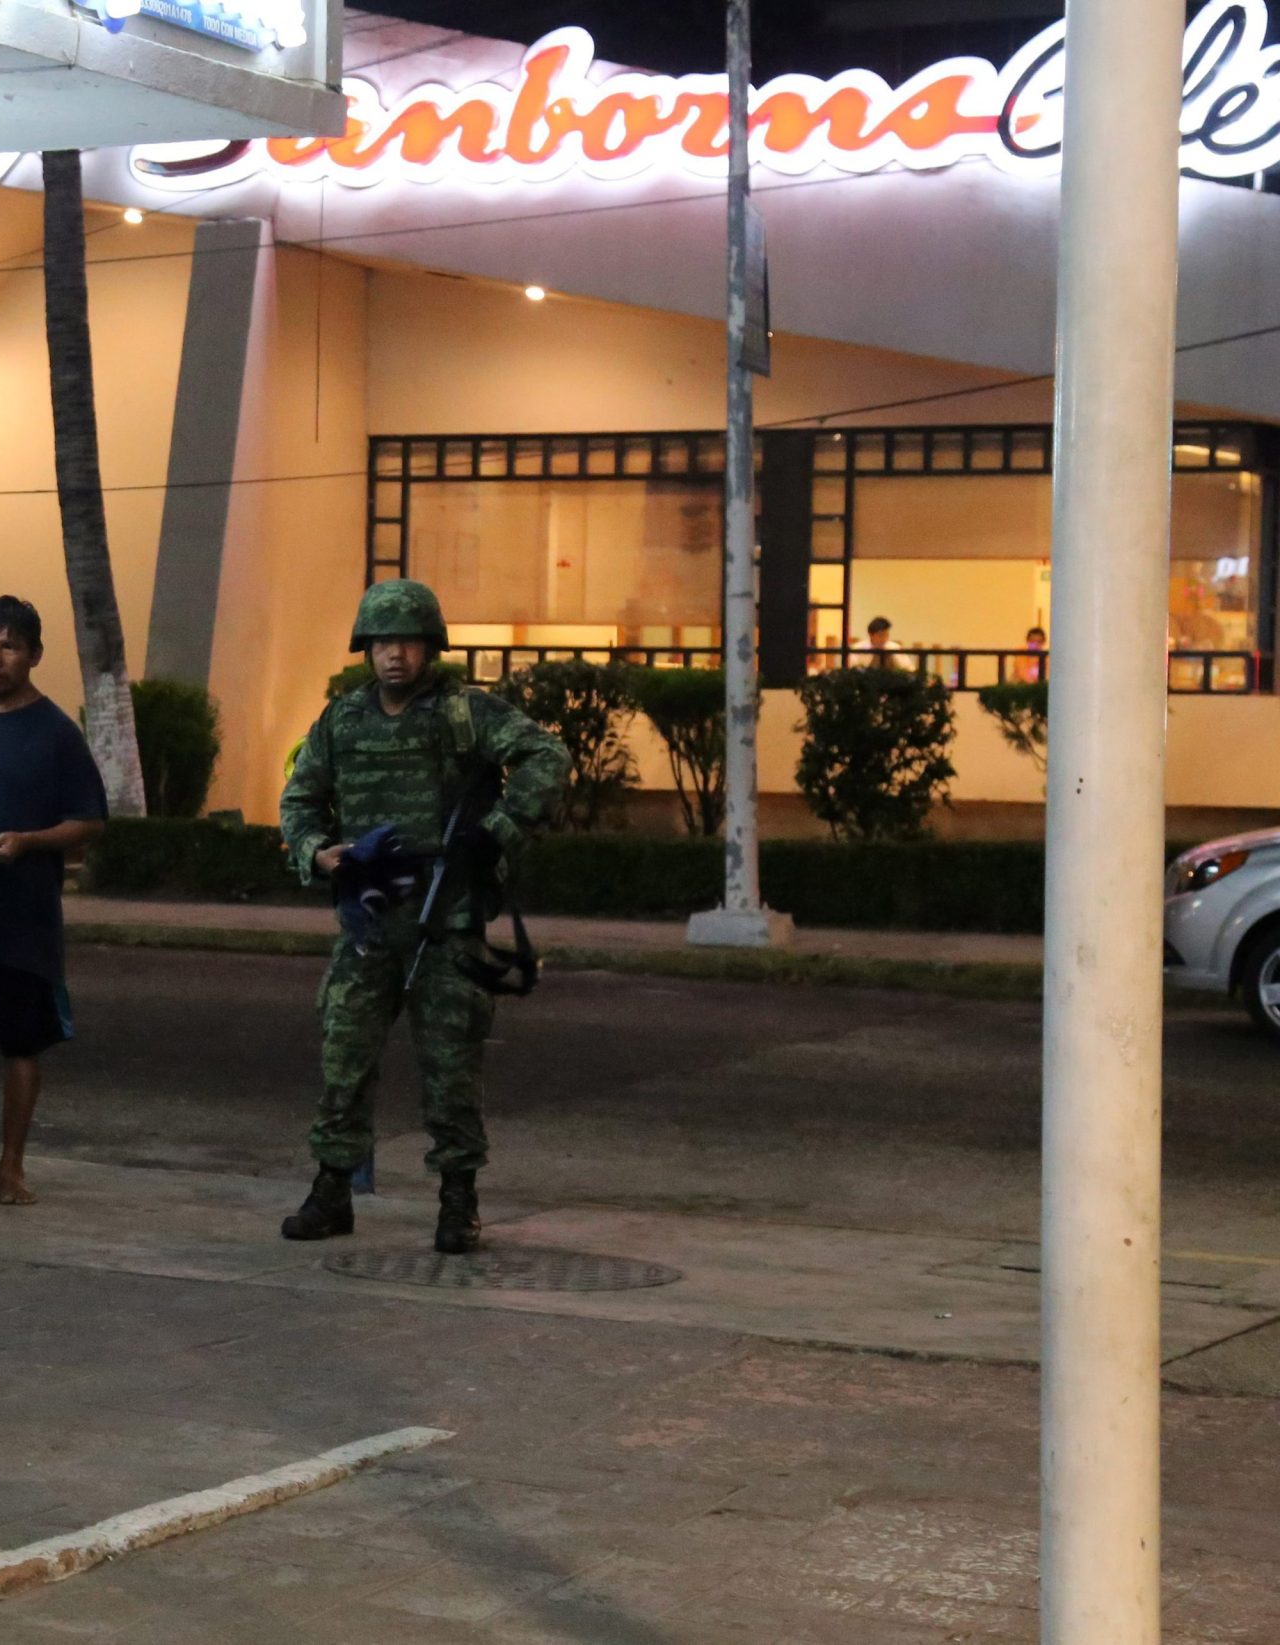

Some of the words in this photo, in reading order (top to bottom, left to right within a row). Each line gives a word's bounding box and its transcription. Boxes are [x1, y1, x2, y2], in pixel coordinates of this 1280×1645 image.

[202, 15, 220, 33] TODO
[221, 21, 233, 39] CON
[134, 45, 982, 177] anborns
